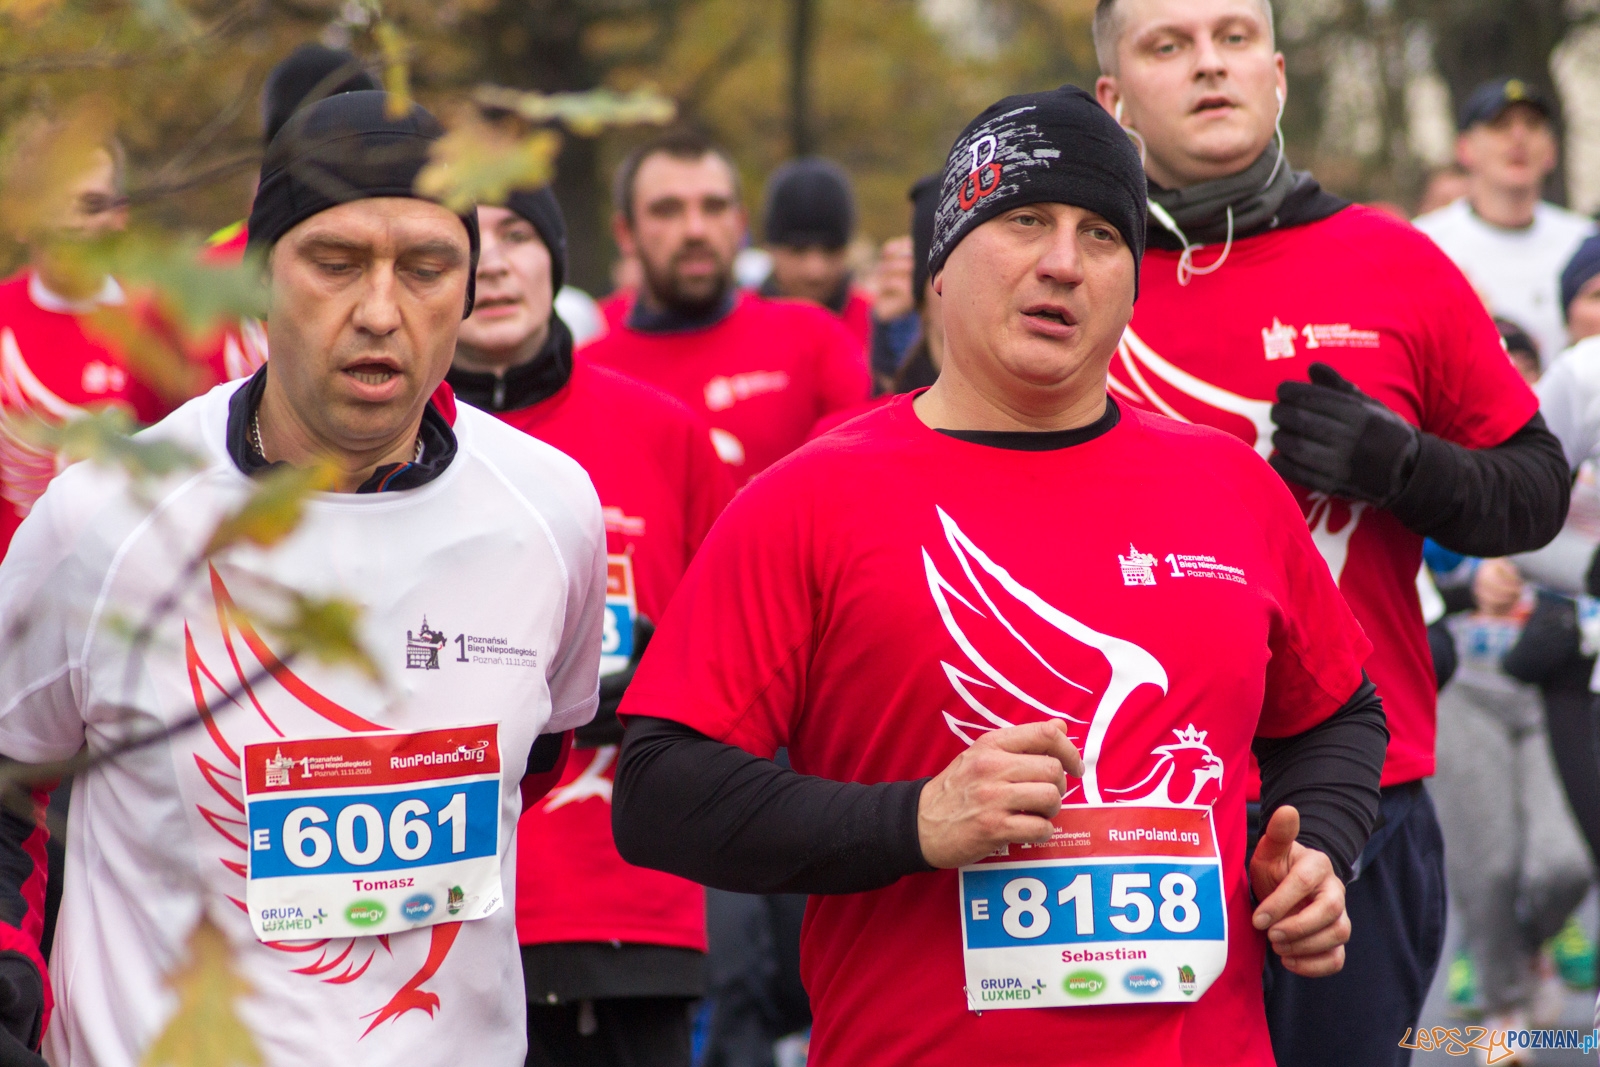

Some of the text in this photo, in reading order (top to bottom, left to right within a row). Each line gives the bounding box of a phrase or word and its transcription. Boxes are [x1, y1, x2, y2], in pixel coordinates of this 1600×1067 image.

[1164, 553, 1185, 577] 1
[1179, 561, 1198, 569] Bieg
[467, 635, 508, 645] Poznański
[454, 633, 470, 663] 1
[467, 644, 538, 657] Bieg Niepodległości
[472, 656, 505, 665] Poznań,
[390, 748, 486, 769] RunPoland.org
[299, 756, 312, 778] 1
[253, 792, 467, 869] E 6061
[1051, 831, 1091, 839] epodległości
[1108, 827, 1200, 845] RunPoland.org
[352, 876, 415, 892] Tomasz
[971, 872, 1201, 940] E 8158
[261, 907, 304, 920] GRUPA
[350, 908, 384, 921] energy
[262, 918, 312, 932] LUXMED
[1061, 948, 1148, 963] Sebastian
[981, 978, 1023, 990] GRUPA
[1069, 981, 1103, 992] energy
[981, 989, 1031, 1001] LUXMED
